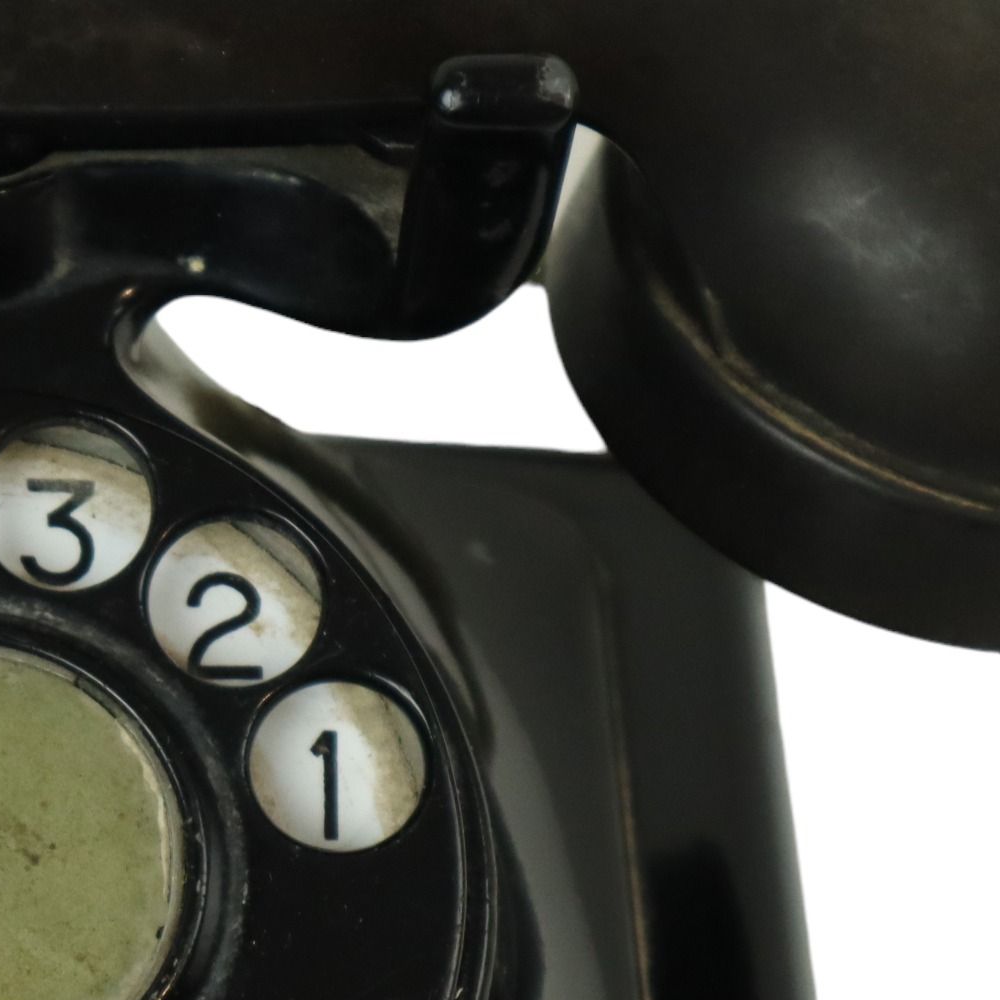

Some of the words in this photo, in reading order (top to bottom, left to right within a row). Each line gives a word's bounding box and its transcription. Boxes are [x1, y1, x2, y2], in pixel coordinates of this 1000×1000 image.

[20, 478, 96, 586] 3
[186, 572, 263, 680] 2
[310, 730, 339, 841] 1
